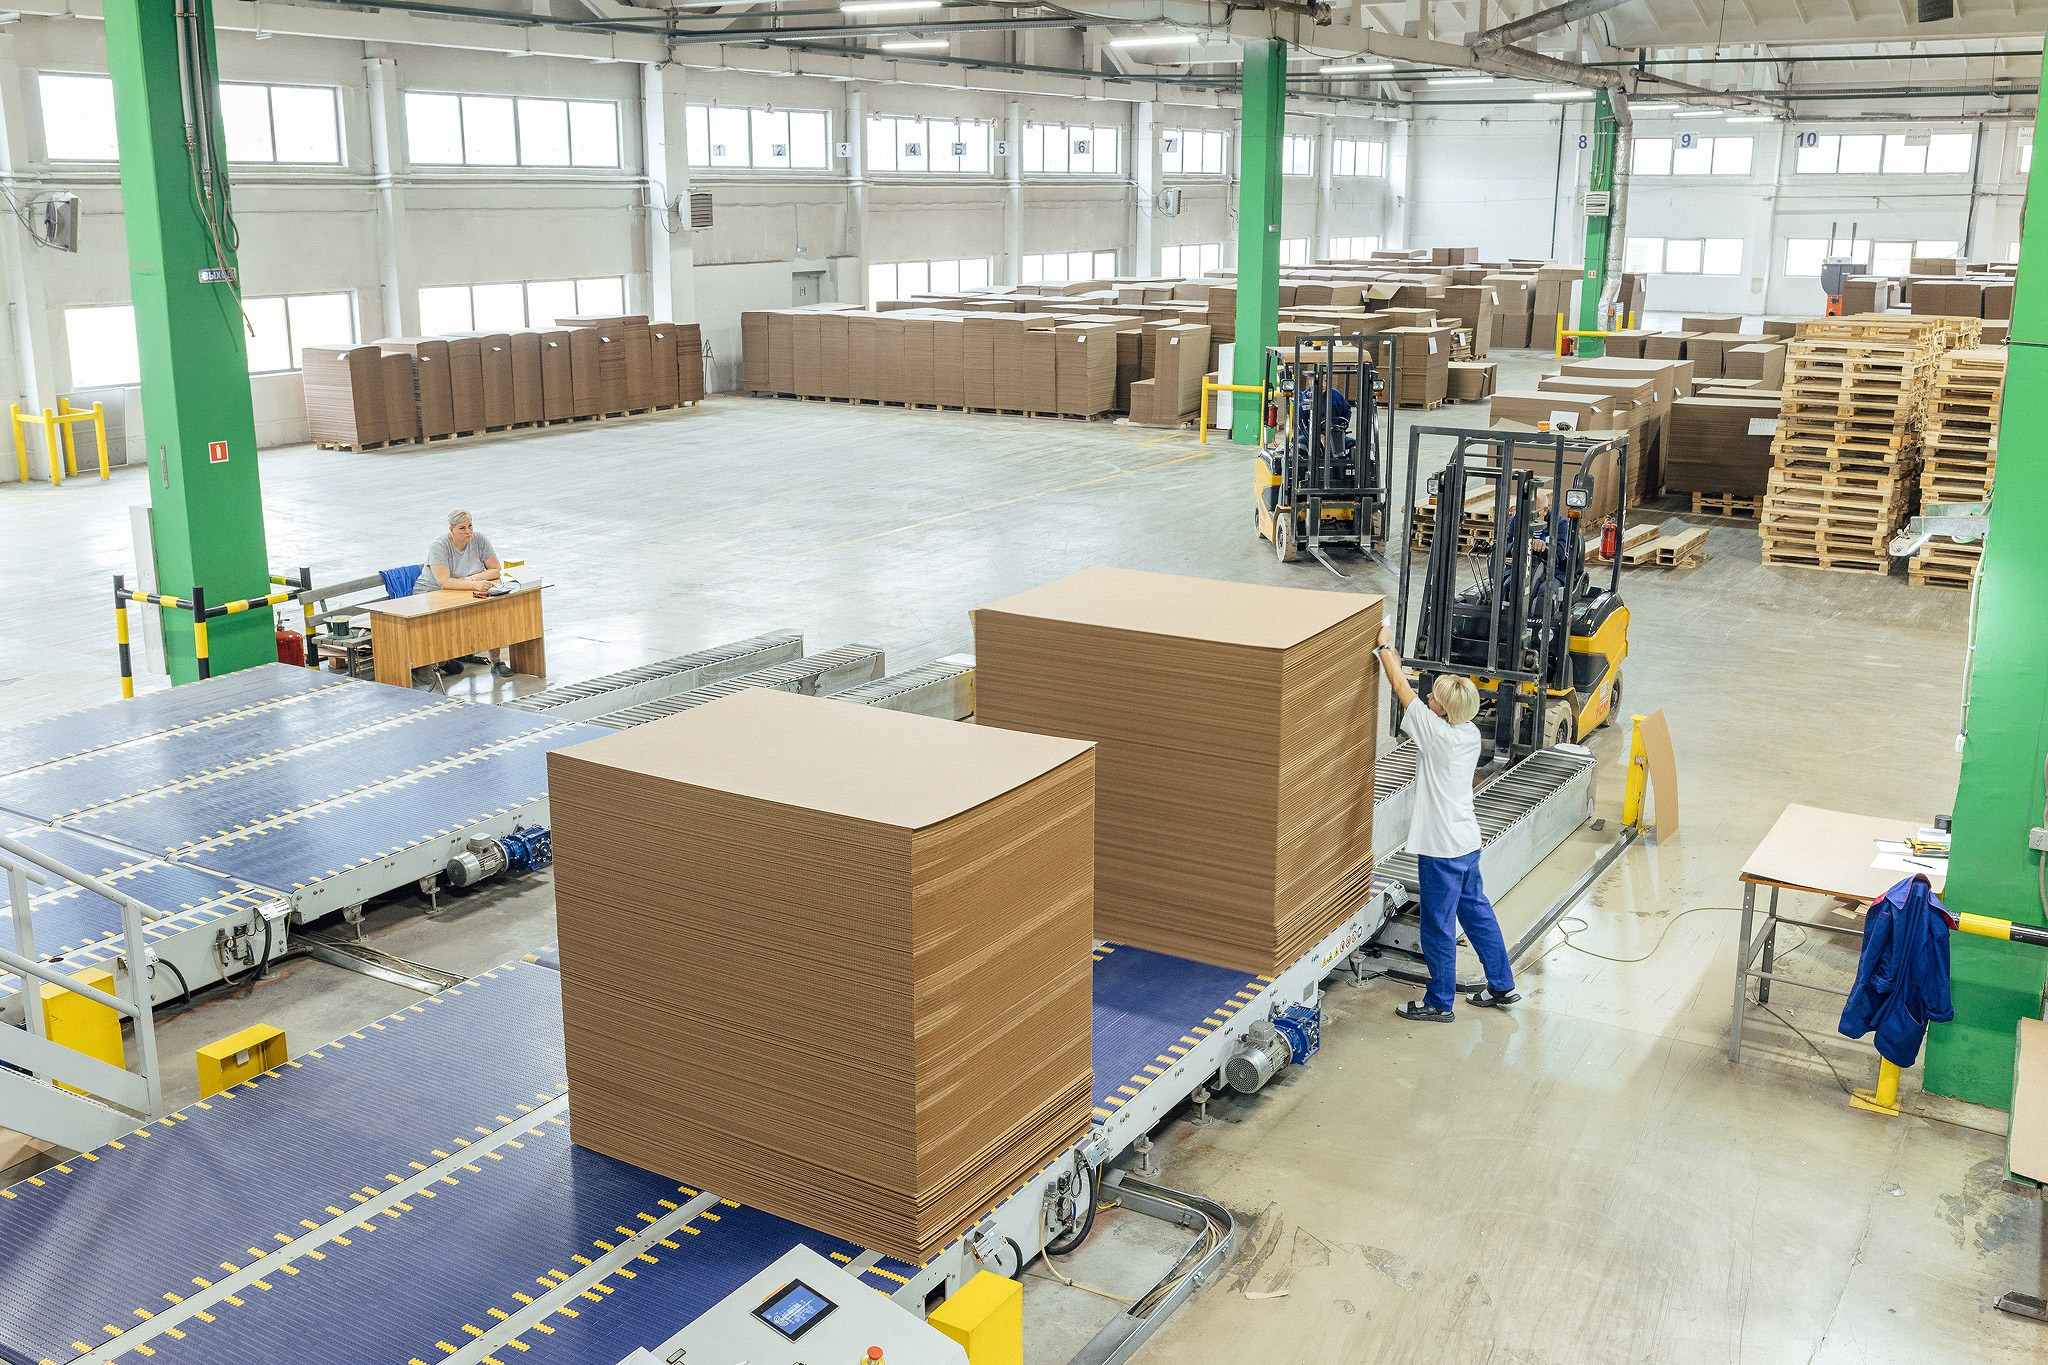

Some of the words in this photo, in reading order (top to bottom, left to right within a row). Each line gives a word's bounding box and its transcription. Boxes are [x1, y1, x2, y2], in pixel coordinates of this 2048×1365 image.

[1578, 134, 1588, 150] 8
[1680, 133, 1692, 148] 9
[1796, 132, 1817, 147] 10
[776, 145, 783, 156] 2
[841, 144, 848, 156] 3
[909, 144, 917, 155] 4
[998, 143, 1006, 155] 5
[1078, 141, 1086, 153] 6
[1165, 140, 1173, 152] 7
